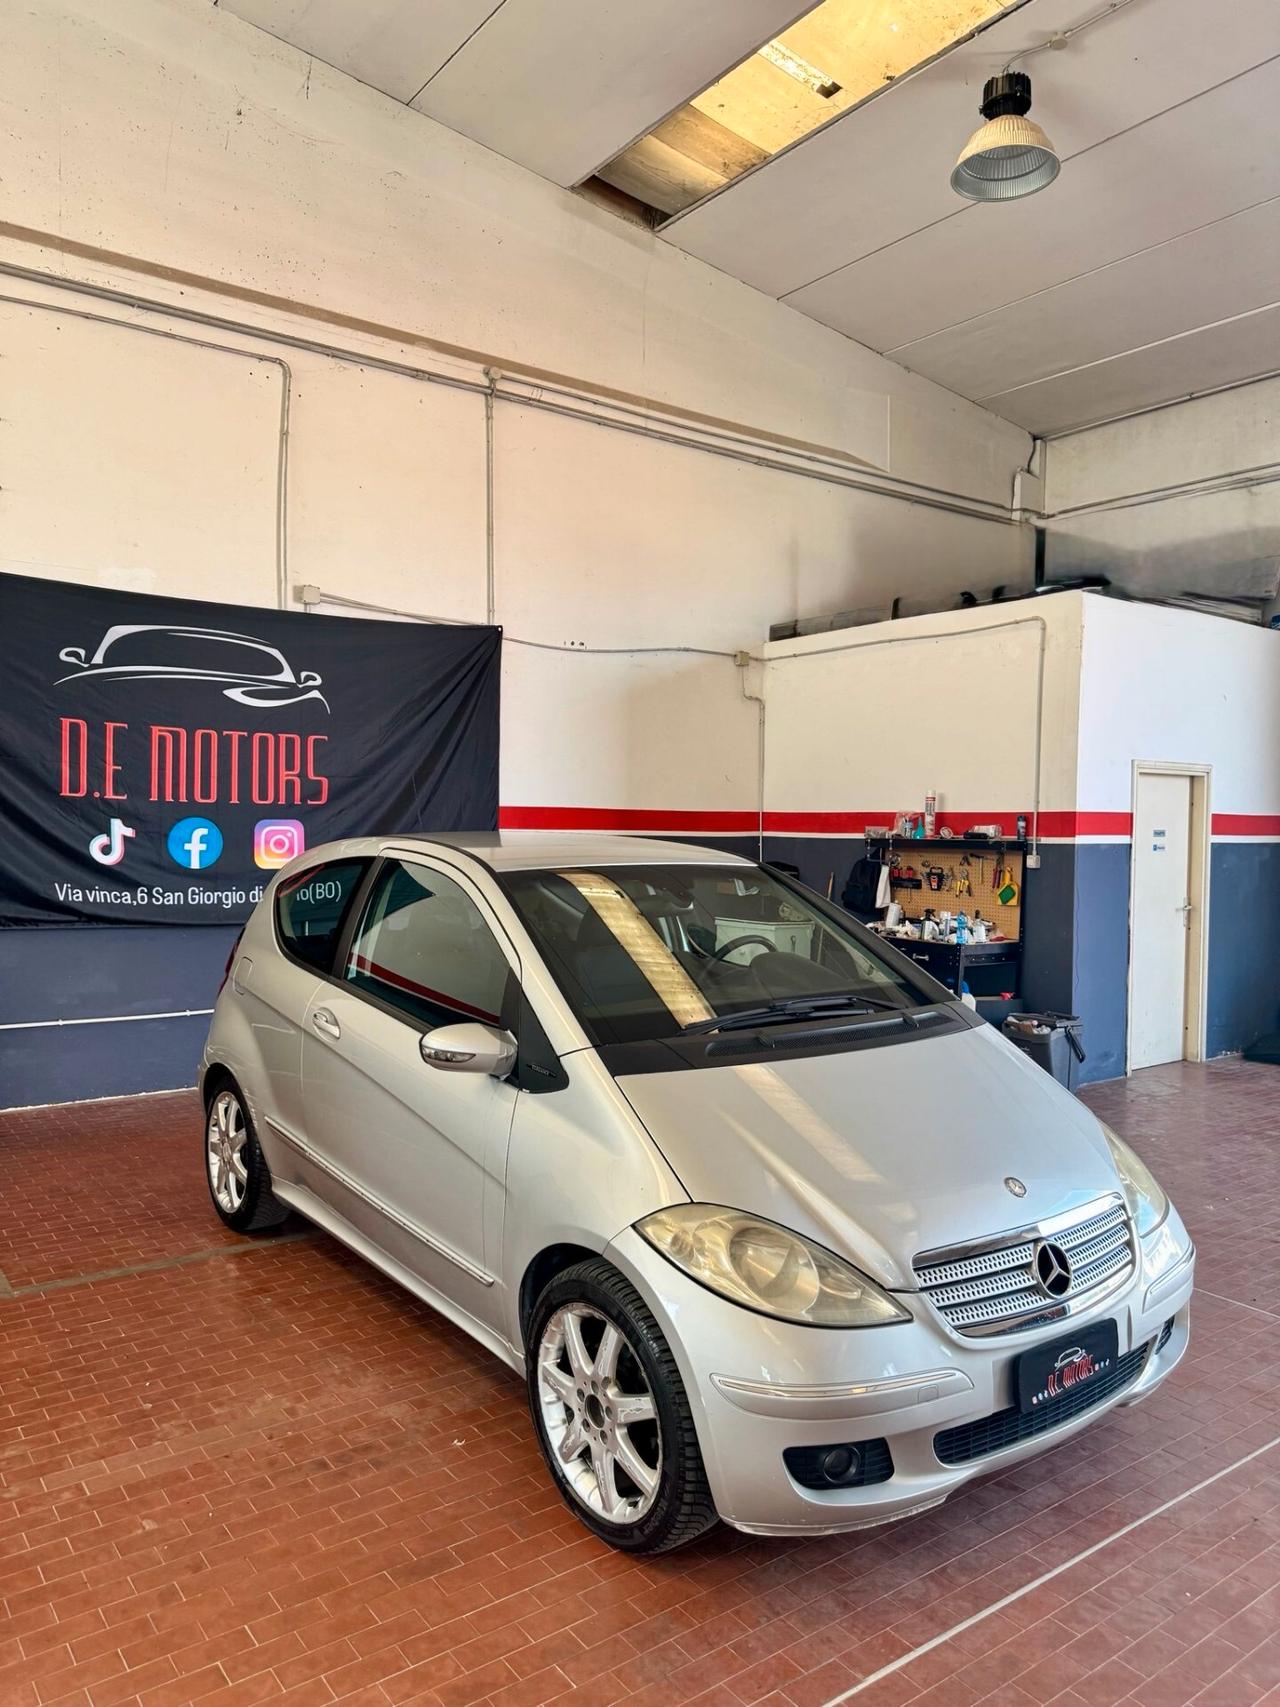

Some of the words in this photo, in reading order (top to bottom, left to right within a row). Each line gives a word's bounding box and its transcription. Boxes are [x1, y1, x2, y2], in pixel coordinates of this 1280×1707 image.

[59, 717, 128, 800] D.E
[149, 725, 329, 805] MOTORS
[54, 882, 82, 902] Via
[85, 886, 148, 906] vinca,6
[152, 887, 184, 905] San
[187, 886, 246, 909] Giorgio
[249, 886, 264, 903] di
[1063, 1354, 1094, 1389] MOTORS
